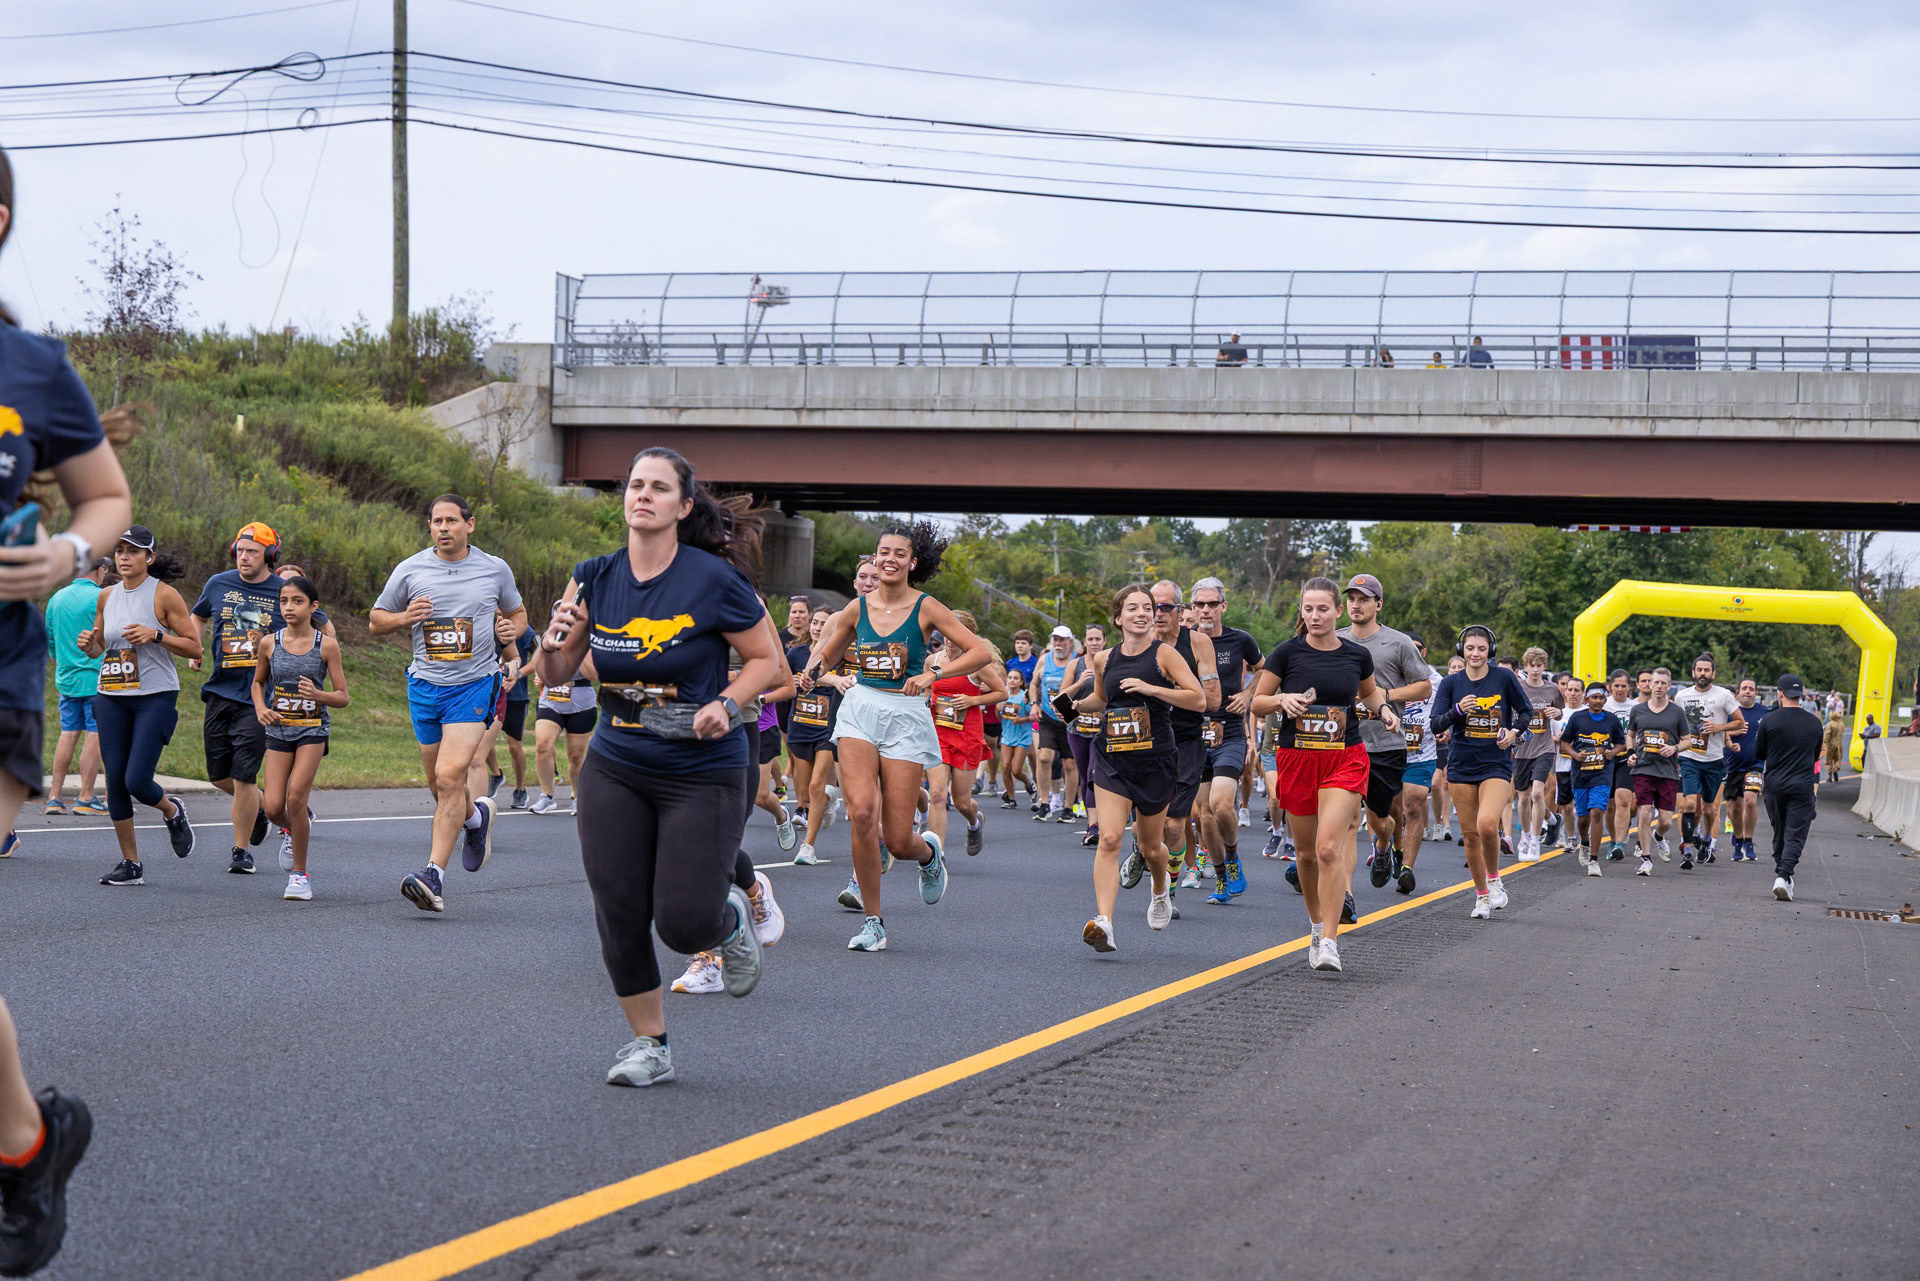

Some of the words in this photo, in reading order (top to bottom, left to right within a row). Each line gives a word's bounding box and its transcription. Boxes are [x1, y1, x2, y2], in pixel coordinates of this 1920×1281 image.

[430, 631, 466, 645] 391
[589, 633, 605, 645] THE
[604, 639, 640, 648] CHASE
[229, 641, 254, 653] 74
[101, 661, 135, 676] 280
[865, 656, 901, 669] 221
[277, 697, 316, 711] 278
[801, 702, 823, 714] 131
[1077, 715, 1100, 725] 333
[1302, 719, 1339, 733] 170
[1468, 717, 1499, 727] 268
[1112, 721, 1140, 735] 171
[1645, 736, 1665, 745] 160
